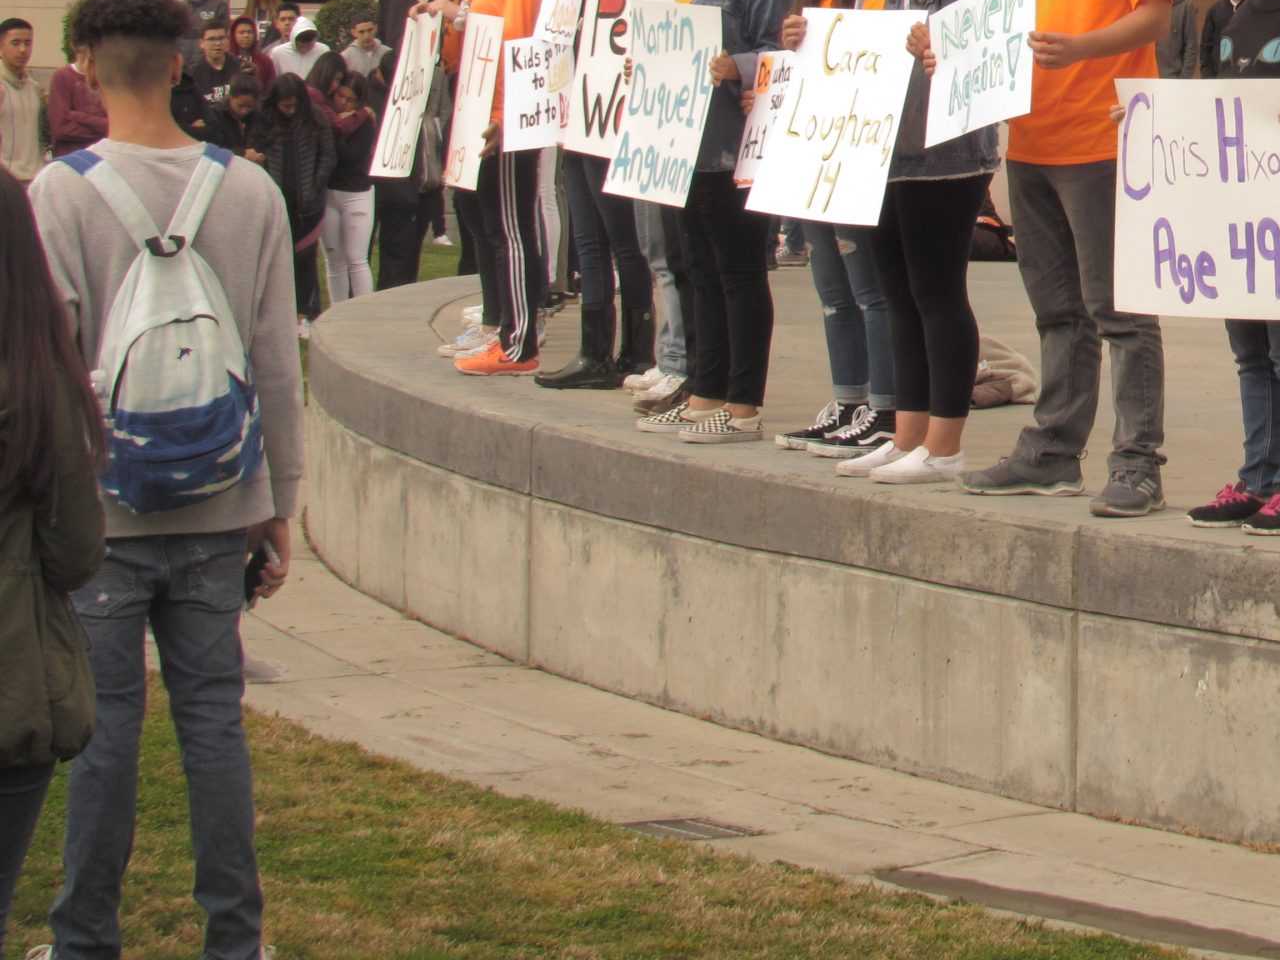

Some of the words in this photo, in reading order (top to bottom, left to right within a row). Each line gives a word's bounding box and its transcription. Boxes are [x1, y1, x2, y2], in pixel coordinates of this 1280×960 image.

[466, 24, 494, 98] 14
[511, 46, 541, 73] Kids
[631, 7, 695, 57] Martin
[823, 13, 883, 76] Cara
[531, 72, 545, 90] to
[628, 63, 690, 129] Duque
[519, 102, 542, 130] not
[544, 98, 557, 124] to
[1122, 92, 1208, 200] Chris
[806, 161, 842, 214] 14
[1153, 217, 1218, 304] Age
